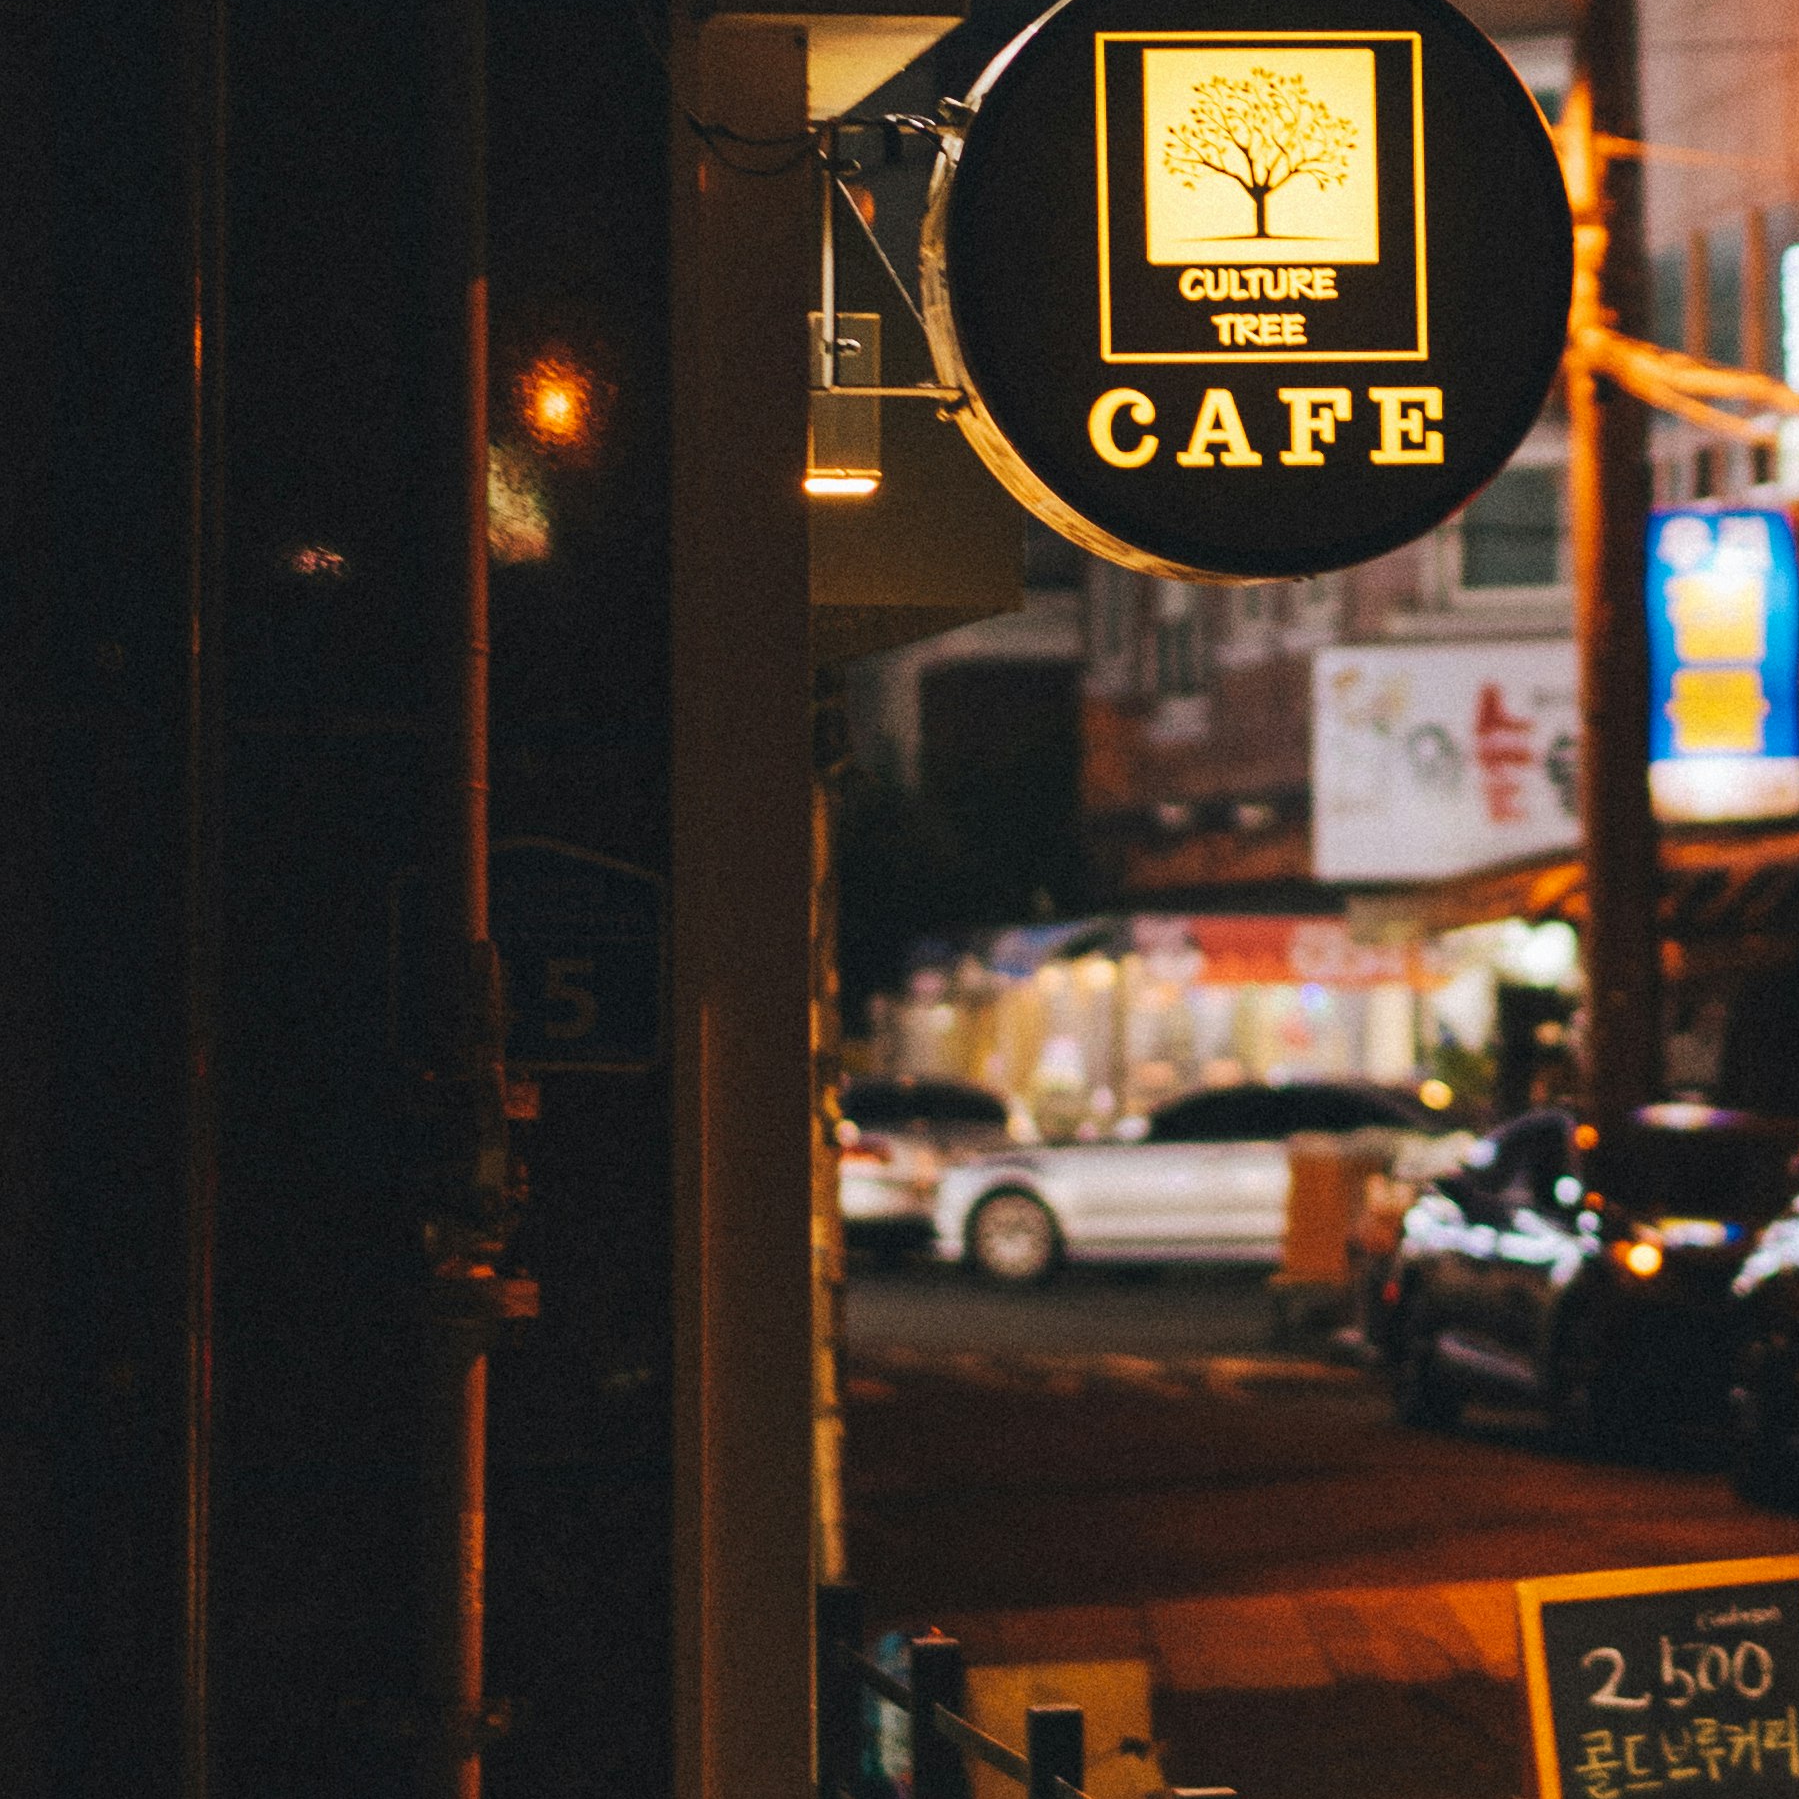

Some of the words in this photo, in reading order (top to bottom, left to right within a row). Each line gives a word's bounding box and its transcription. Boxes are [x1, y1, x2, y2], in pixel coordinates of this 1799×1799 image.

[1178, 266, 1339, 302] CULTURE
[1210, 312, 1308, 347] TREE
[1086, 385, 1446, 469] CAFE
